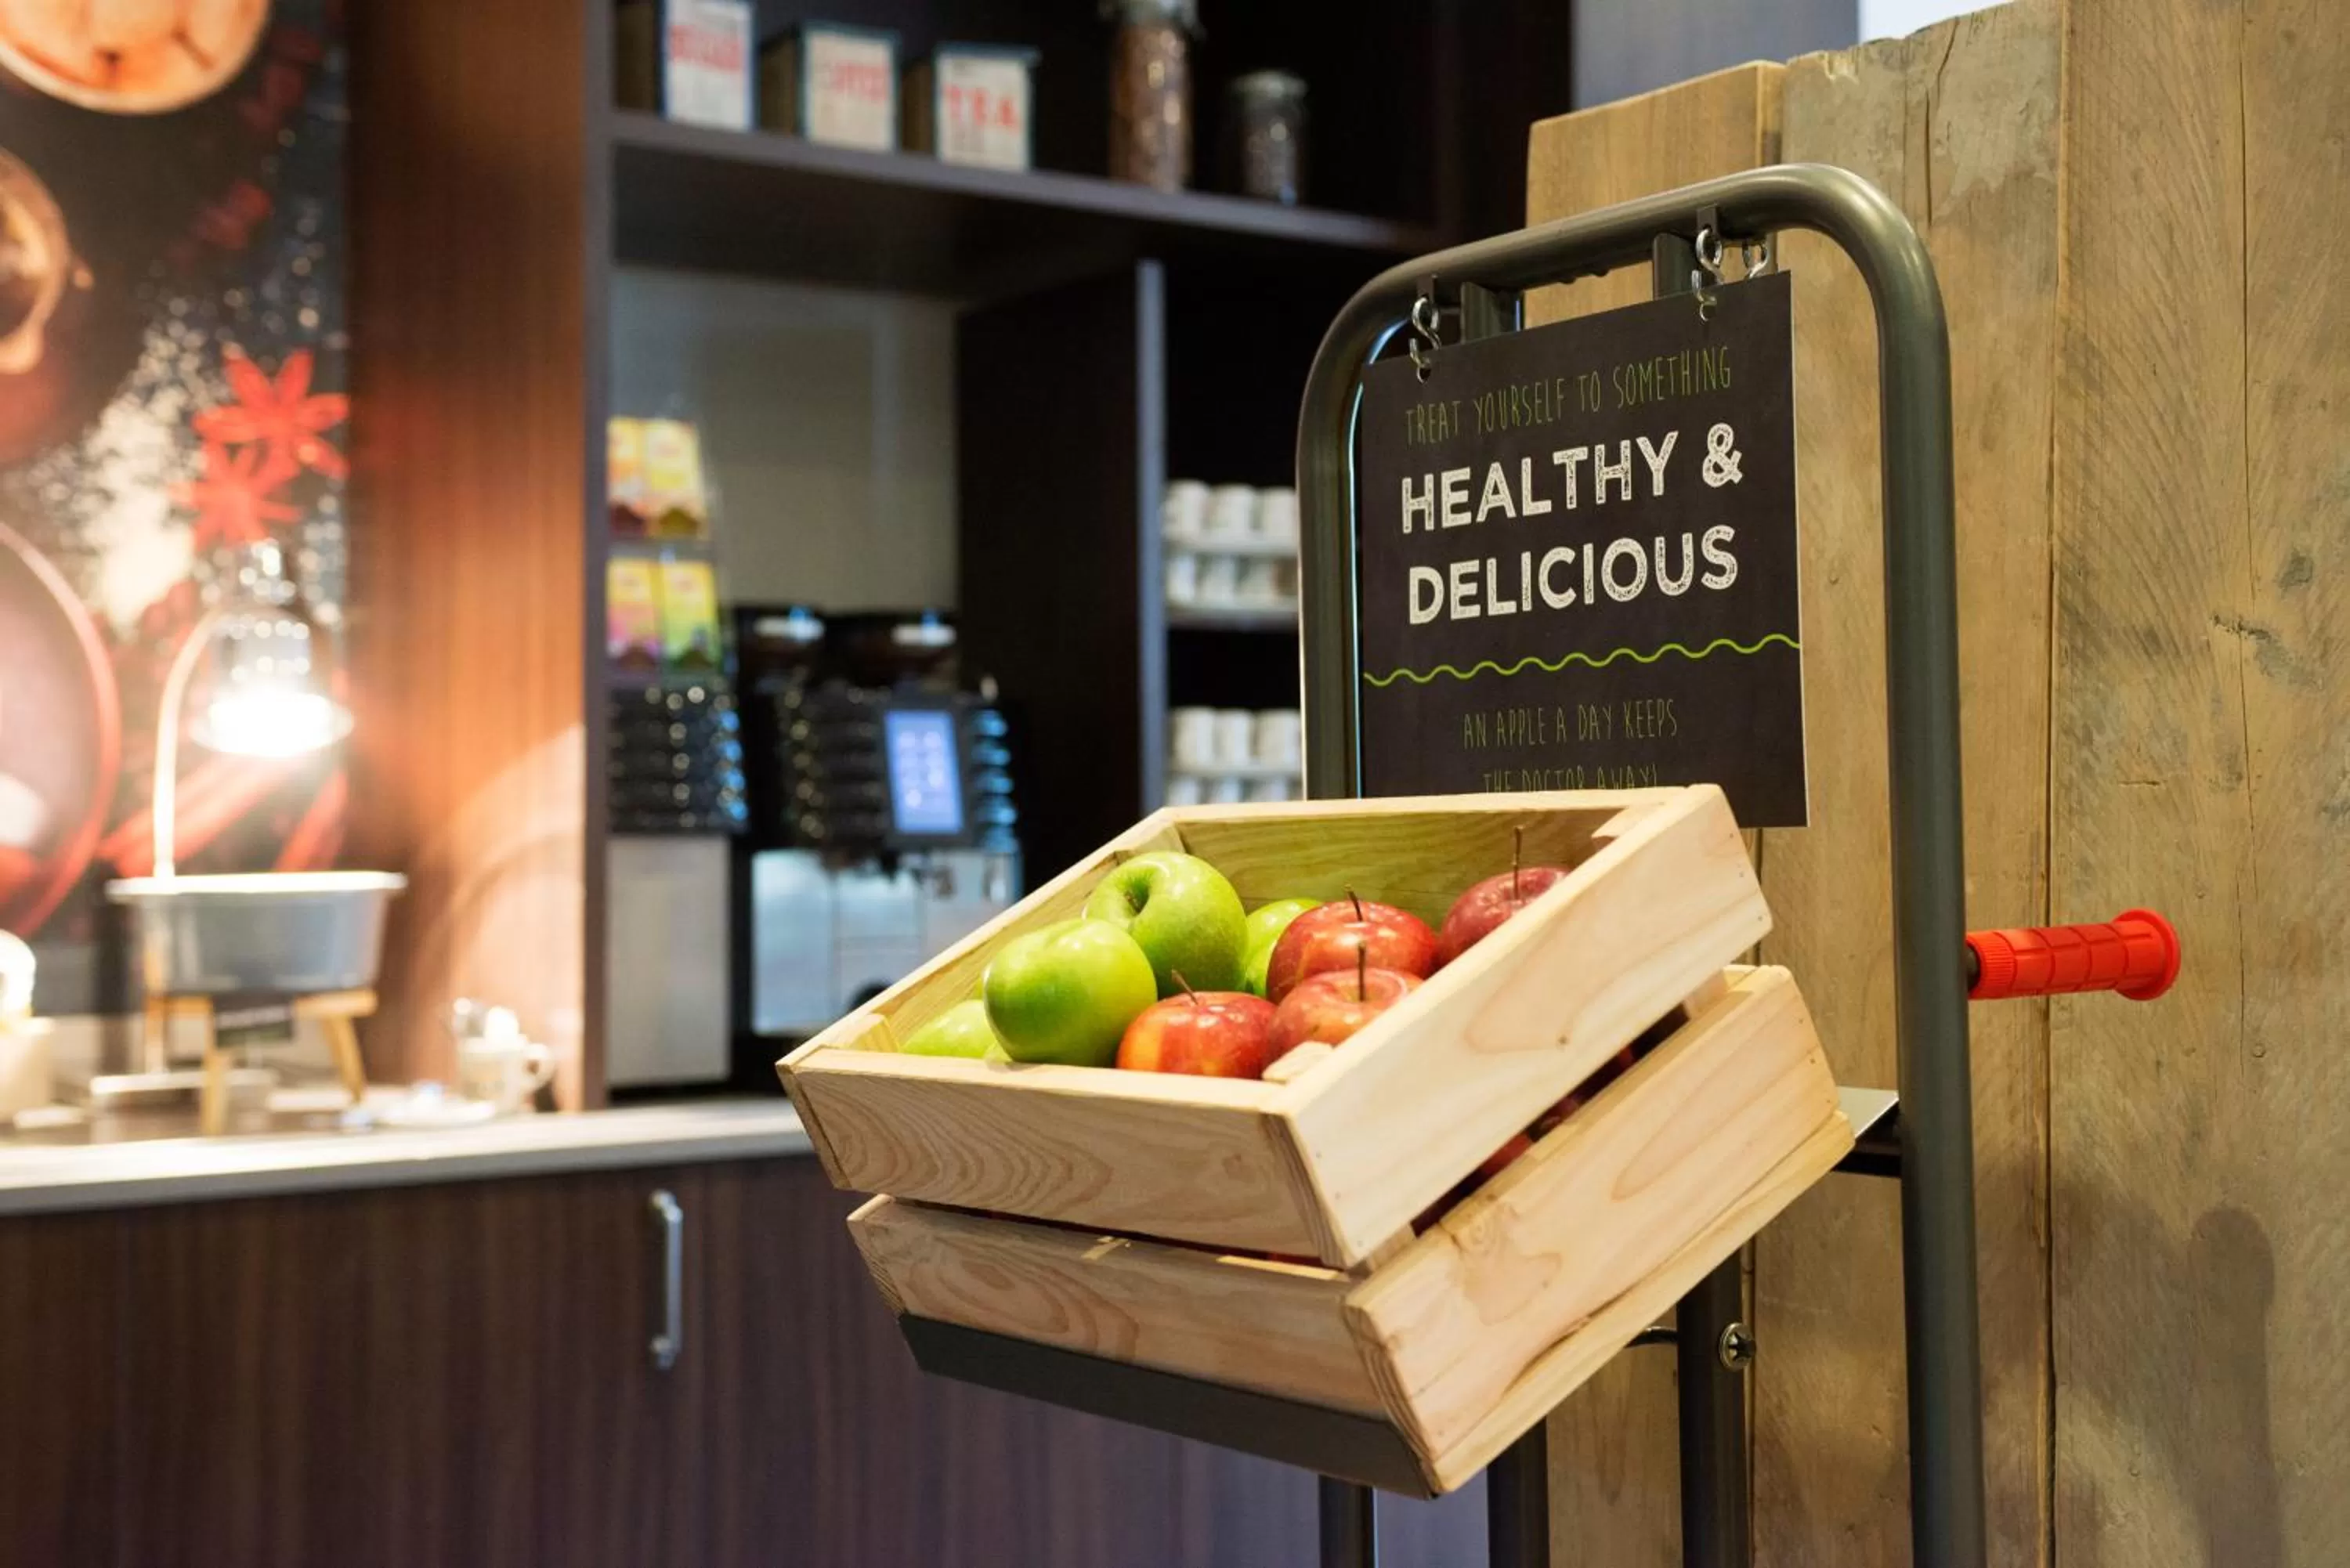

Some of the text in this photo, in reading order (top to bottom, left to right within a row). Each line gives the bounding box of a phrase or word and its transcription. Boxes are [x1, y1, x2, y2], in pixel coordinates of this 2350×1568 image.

[1406, 345, 1732, 445] TREAT YOURSELF TO SOMETHING
[1401, 423, 1743, 534] HEALTHY &
[1409, 524, 1738, 625] DELICIOUS
[1463, 697, 1678, 750] AN APPLE A DAY KEEPS
